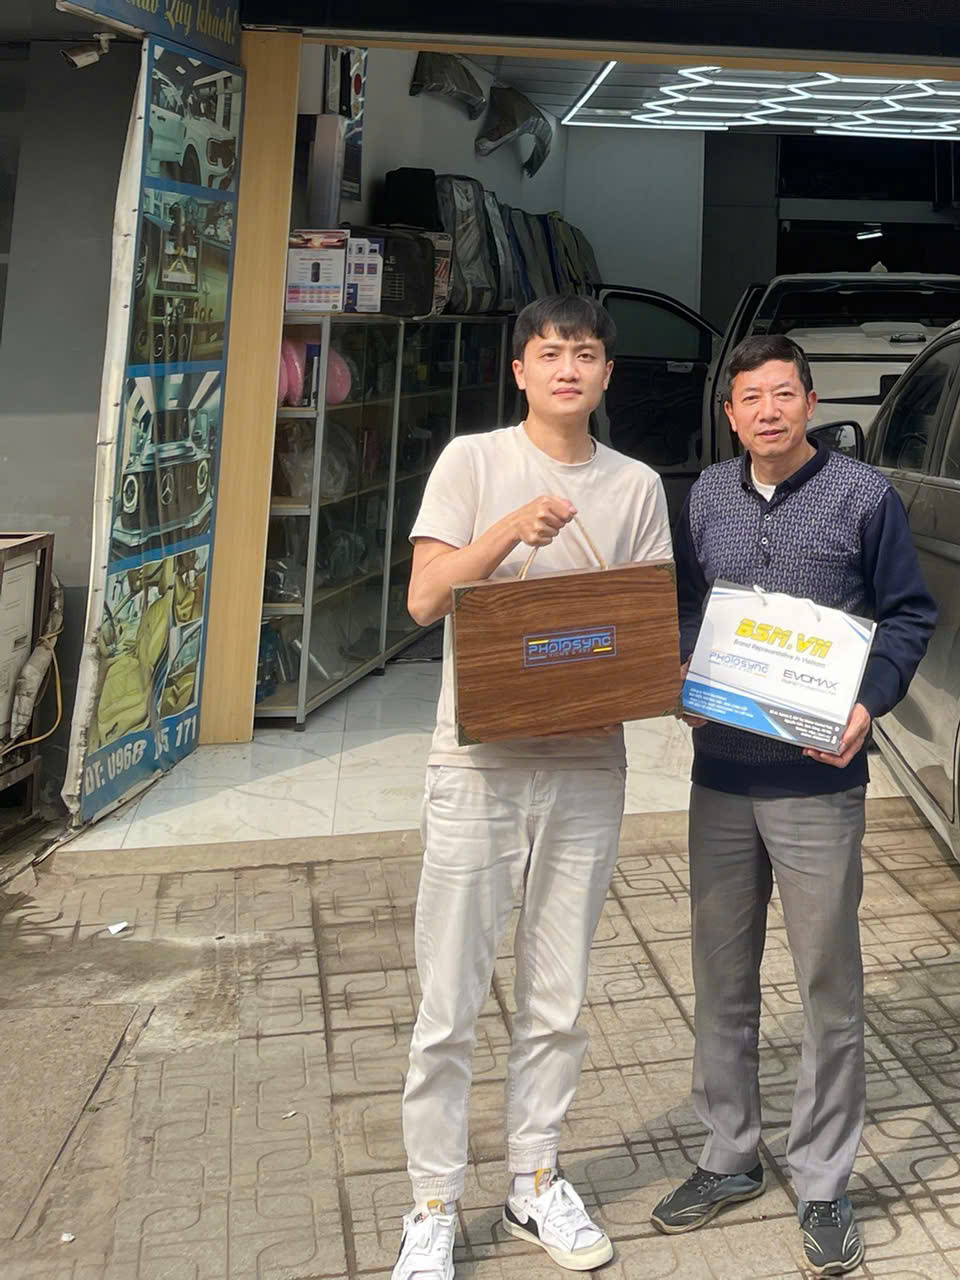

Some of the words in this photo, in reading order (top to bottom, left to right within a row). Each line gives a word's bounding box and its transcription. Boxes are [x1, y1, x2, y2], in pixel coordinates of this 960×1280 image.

[528, 631, 612, 655] PHOTOSYNC
[735, 617, 833, 659] BSM.VN
[709, 650, 770, 675] PHOTOSYNC
[783, 668, 841, 690] EVOMAX
[175, 715, 197, 747] 171
